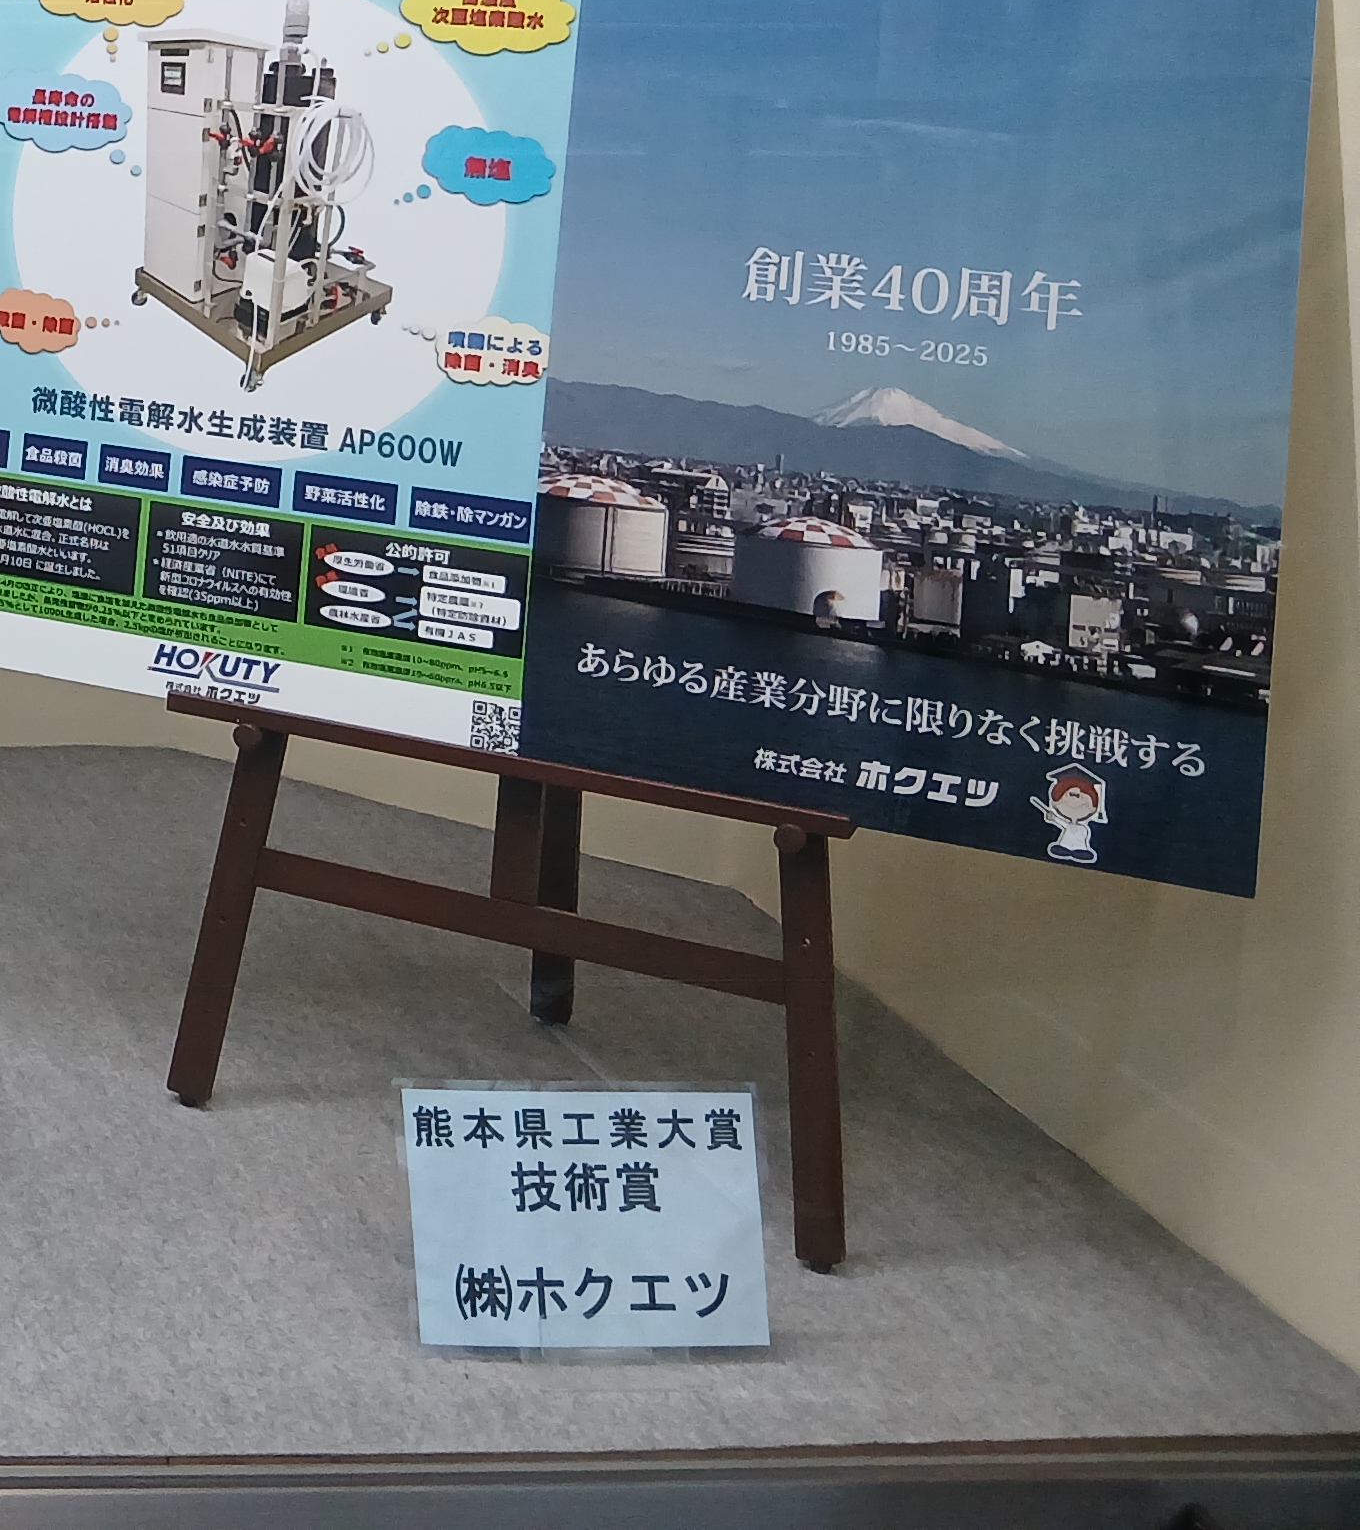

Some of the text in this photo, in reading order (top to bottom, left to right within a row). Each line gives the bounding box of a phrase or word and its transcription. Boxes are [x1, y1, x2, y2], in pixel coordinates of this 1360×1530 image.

[742, 246, 1083, 331] 創業40周年
[31, 385, 463, 467] 微酸性電解水生成装置 AP600W
[25, 444, 83, 469] 食品殺菌
[104, 454, 165, 480] 消臭効果
[192, 468, 271, 496] 感染症予防
[303, 484, 387, 512] 野菜活性化
[181, 512, 271, 538] 安全及び効果
[414, 500, 528, 530] 除鉄・除マンガン
[385, 542, 451, 565] 公的許可
[152, 642, 282, 684] HOKUTY
[576, 641, 1207, 778] あらゆる産業分野に限りなく挑戦する
[753, 747, 999, 808] 株式会社 ホクエツ
[412, 1106, 743, 1151] 熊本県工業大賞
[511, 1161, 662, 1212] 技術賞
